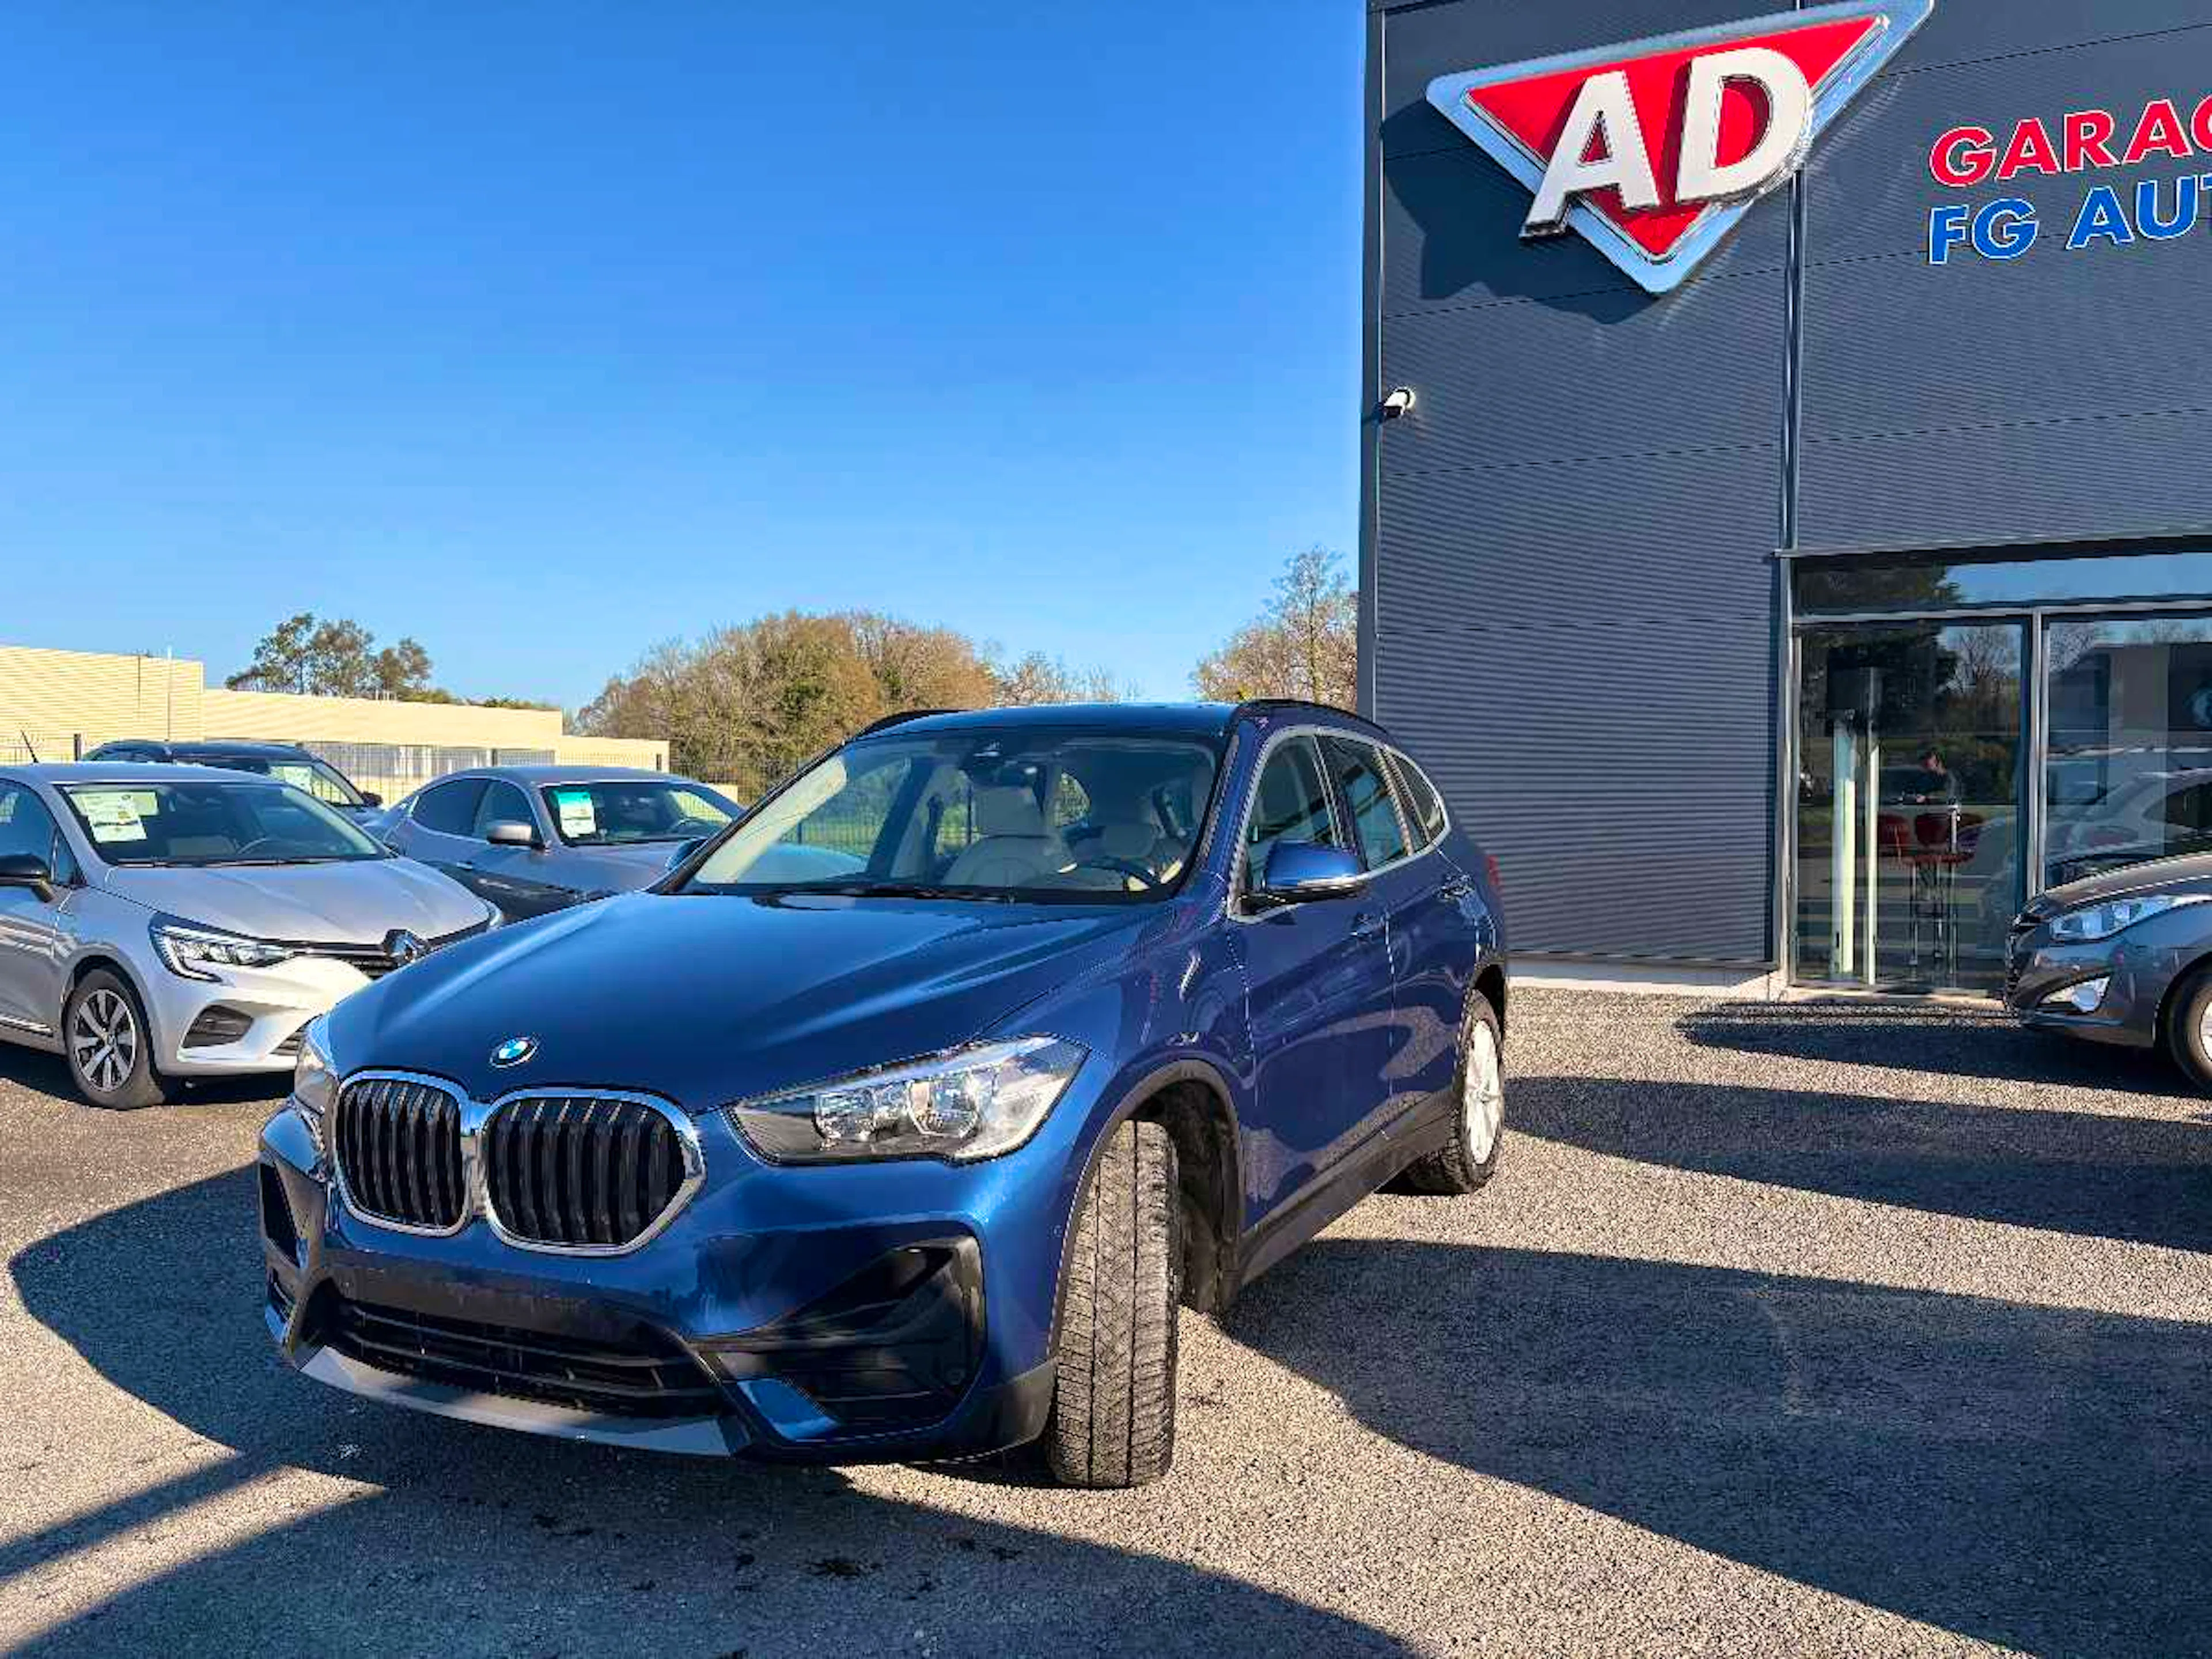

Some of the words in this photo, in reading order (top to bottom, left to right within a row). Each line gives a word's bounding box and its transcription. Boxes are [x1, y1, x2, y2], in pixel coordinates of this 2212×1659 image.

[1520, 47, 1812, 237] AD
[1929, 197, 2040, 265] FG
[2065, 172, 2212, 250] AU
